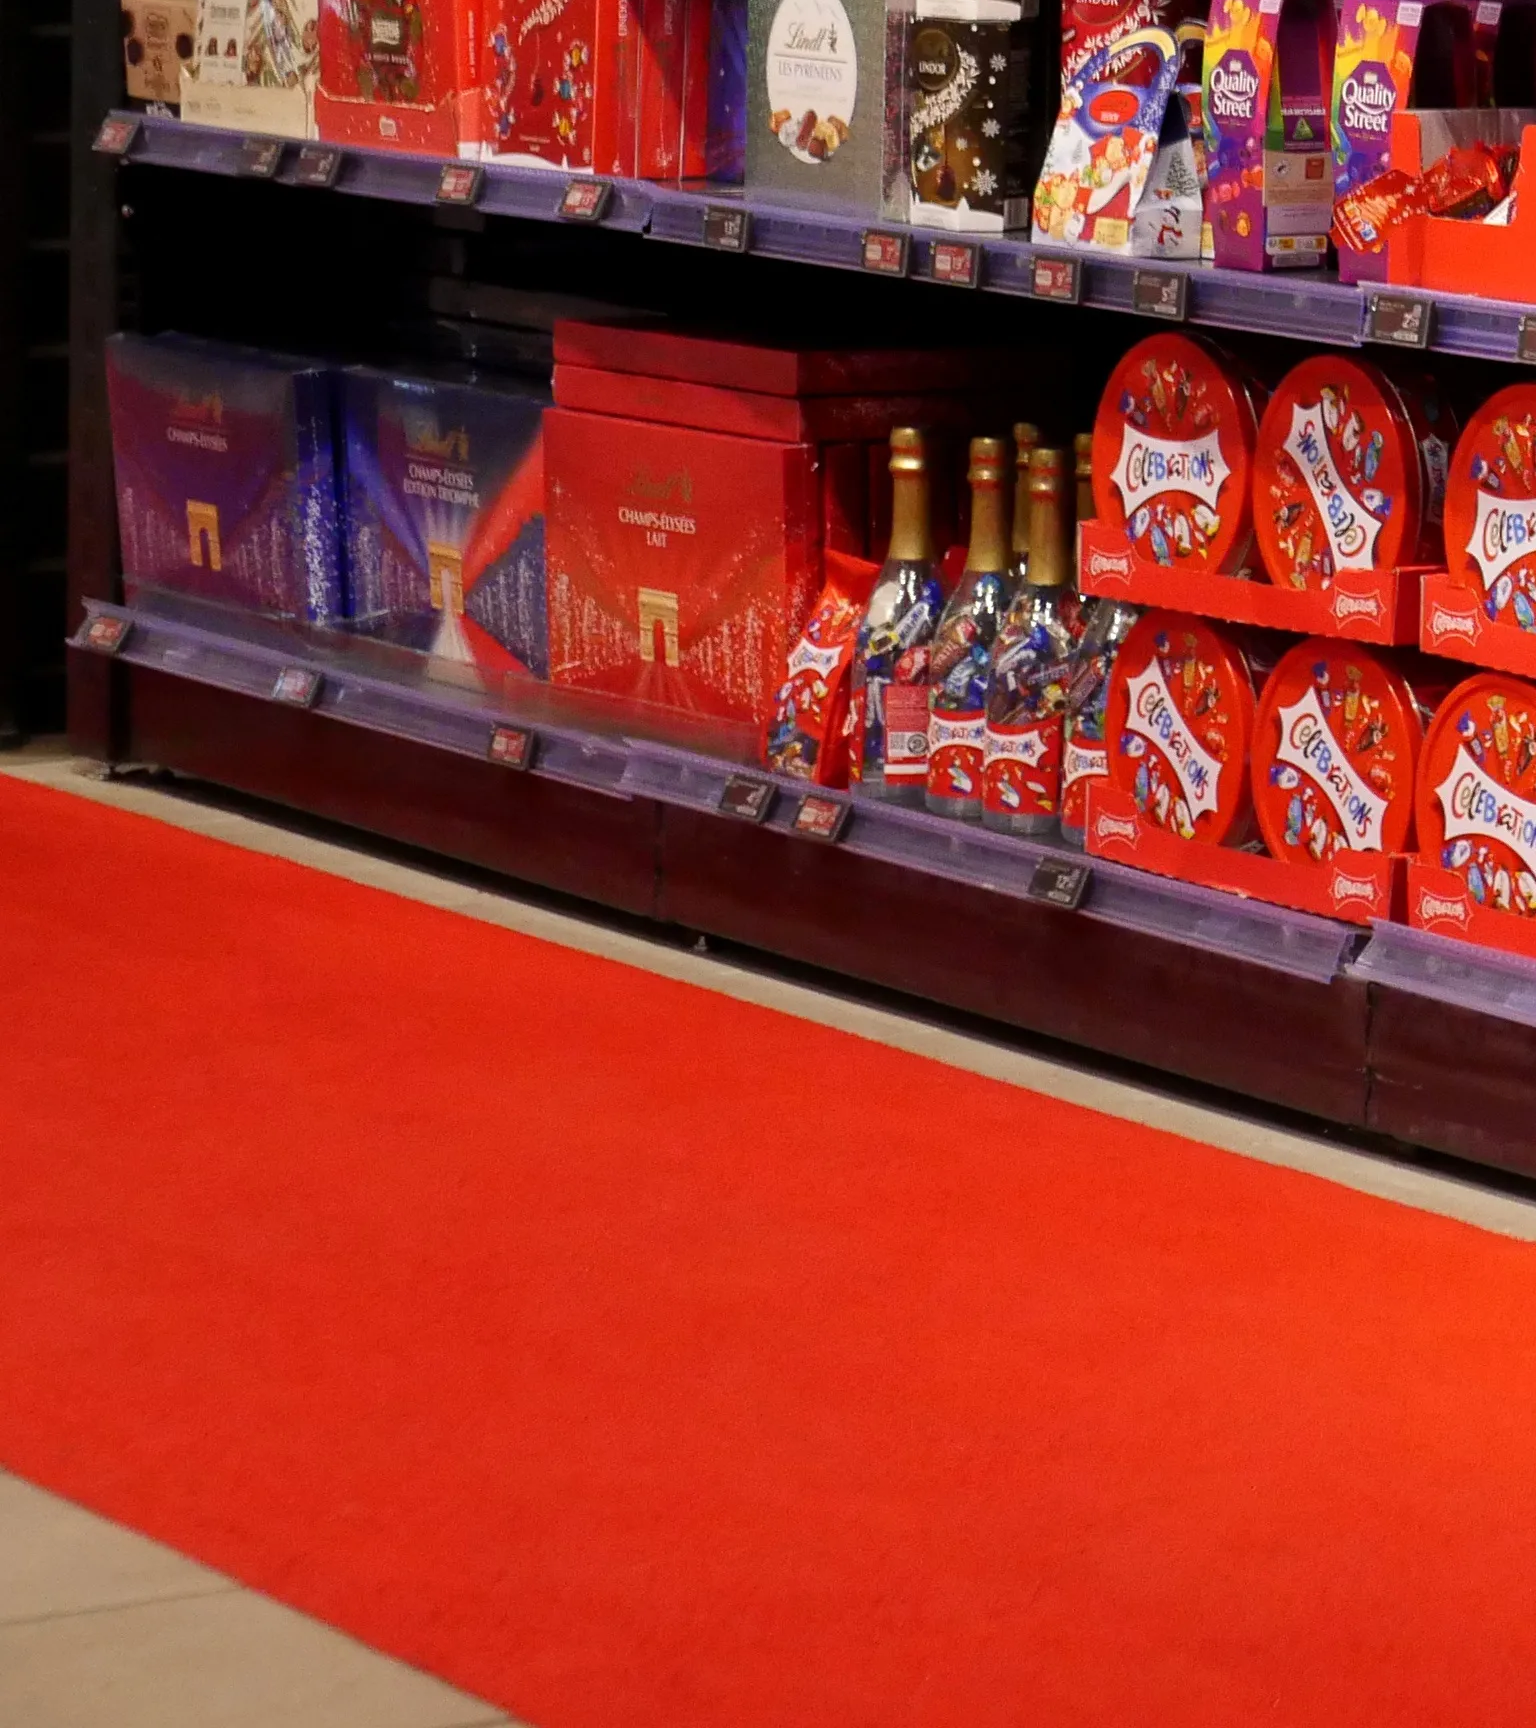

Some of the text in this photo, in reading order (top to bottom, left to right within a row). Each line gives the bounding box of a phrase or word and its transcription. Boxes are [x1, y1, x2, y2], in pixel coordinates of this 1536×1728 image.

[785, 20, 828, 51] Lindt
[918, 60, 947, 74] LINDOR
[1210, 67, 1259, 99] Quality
[1342, 79, 1396, 111] Quality
[1214, 95, 1253, 119] Street
[1344, 105, 1388, 131] Street
[618, 505, 696, 536] CHAMPS-ÉLYSÉES
[646, 530, 668, 549] LAIT
